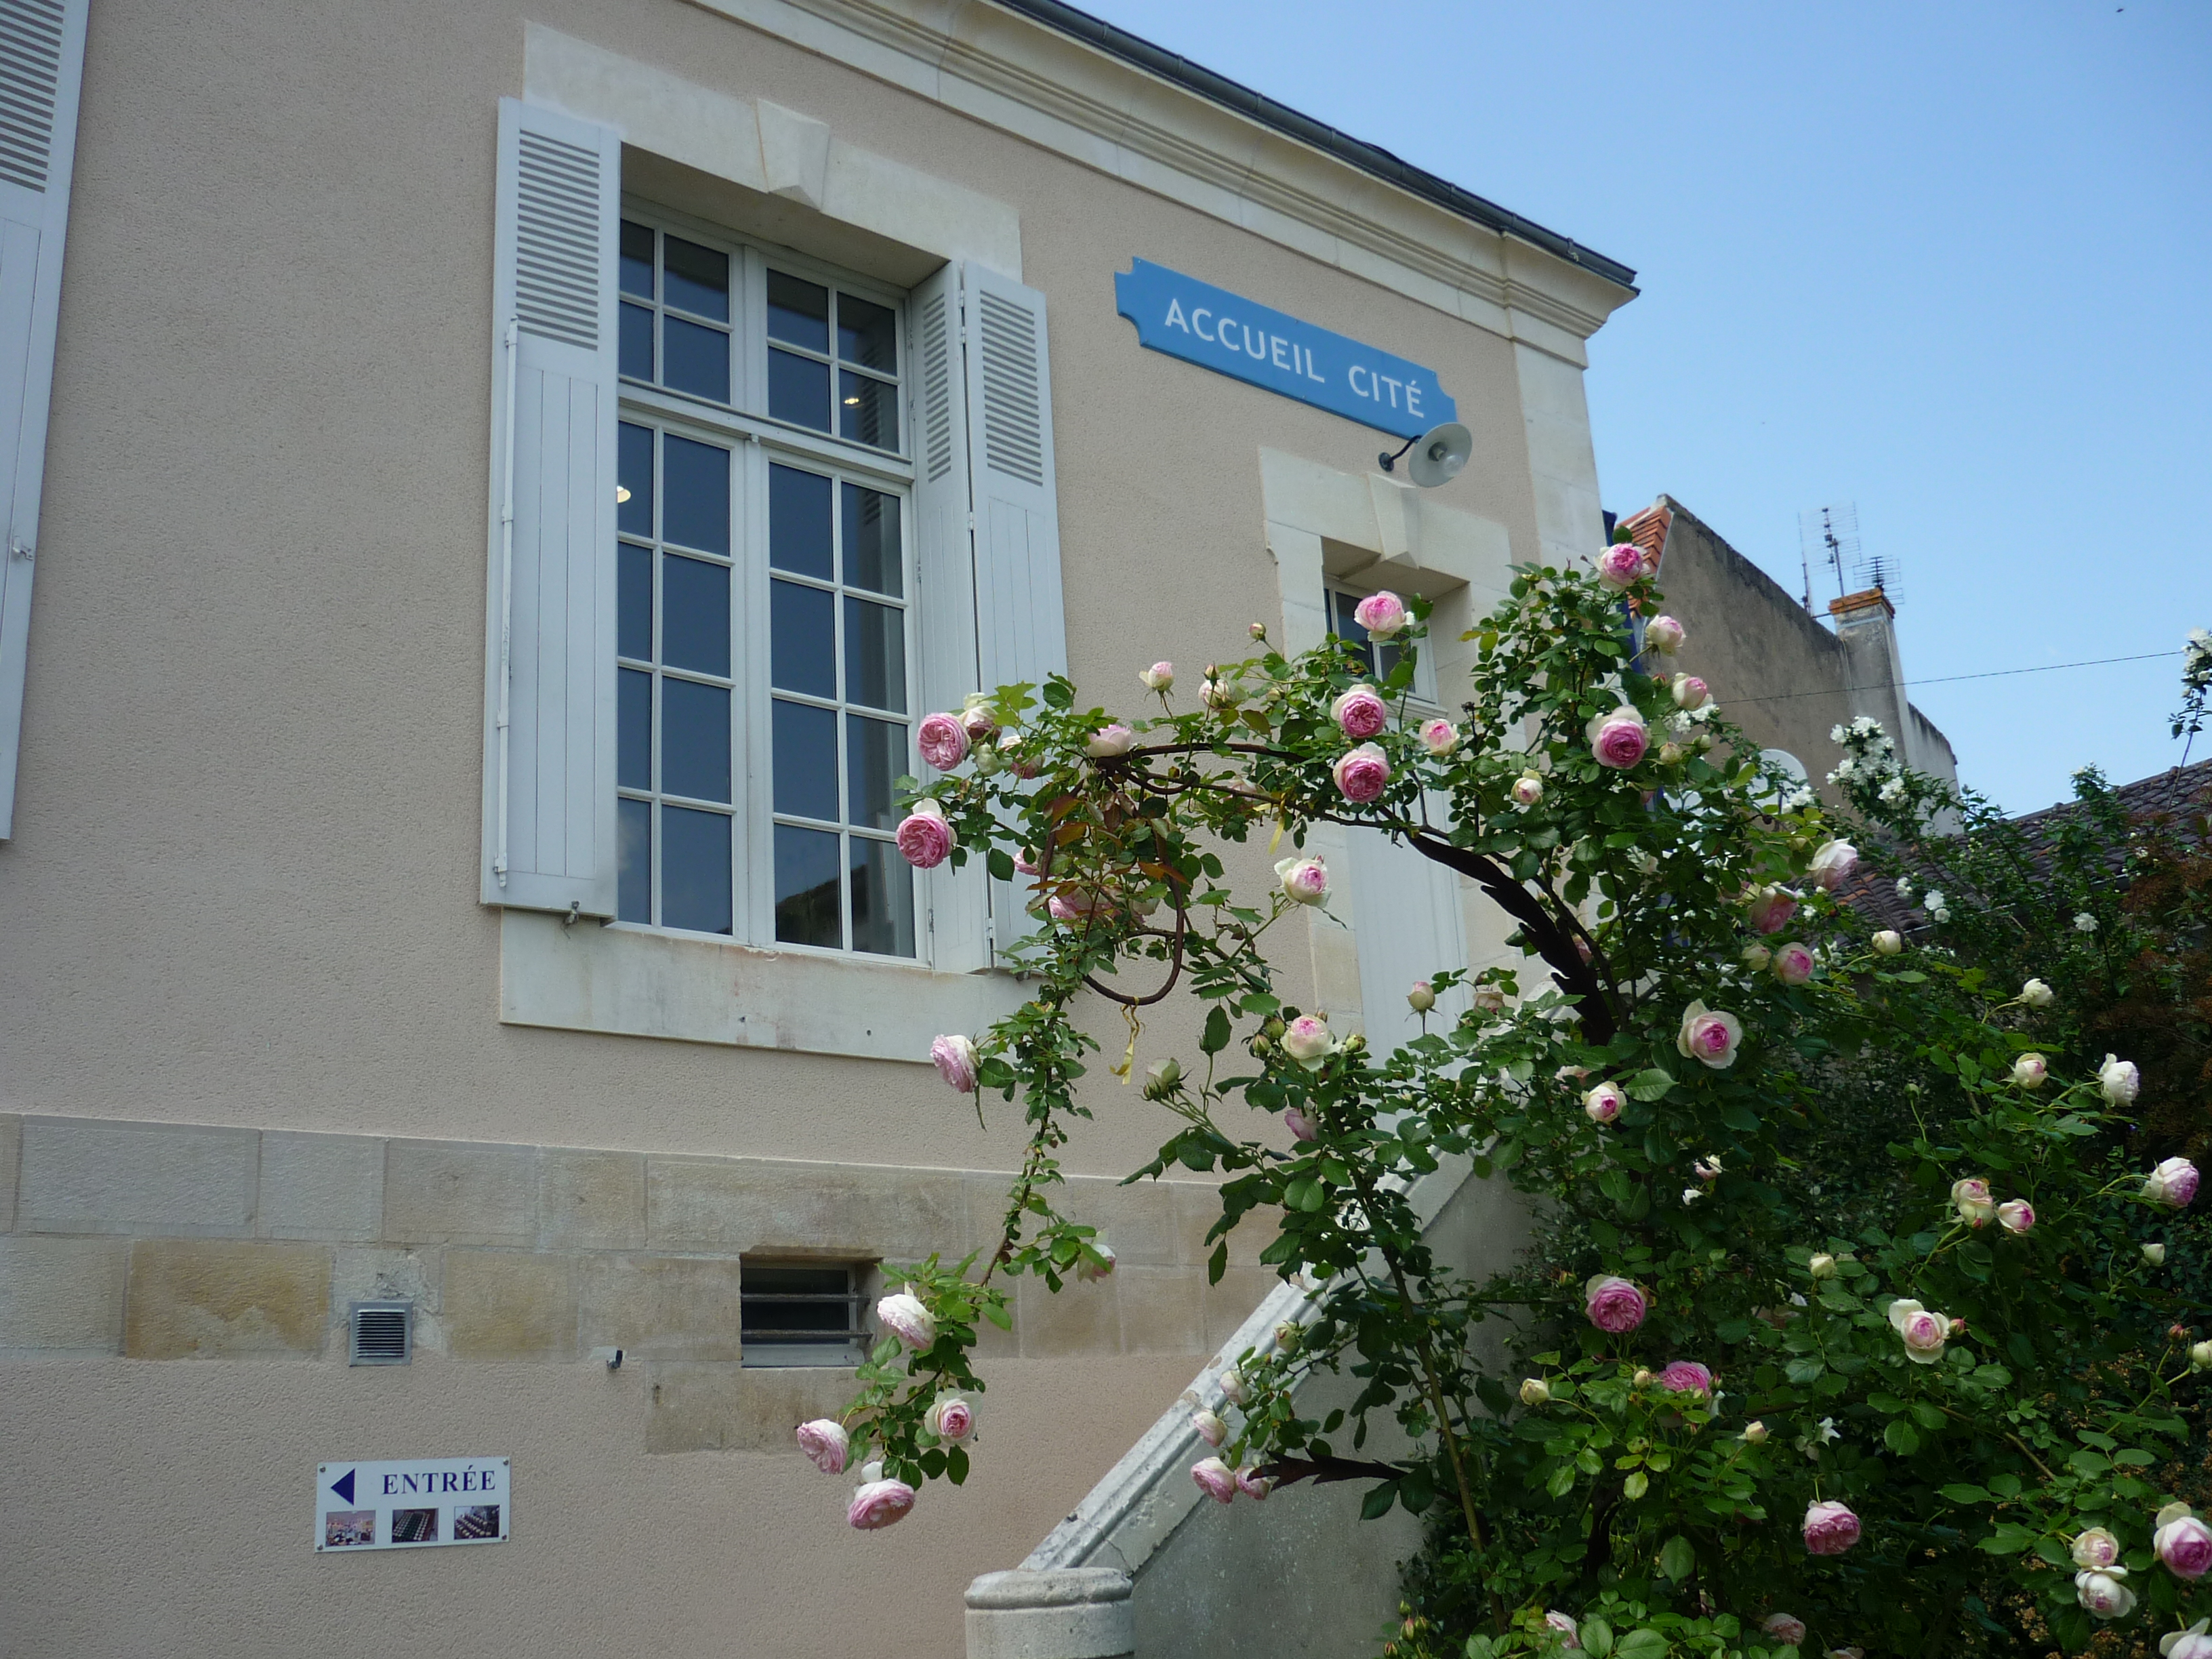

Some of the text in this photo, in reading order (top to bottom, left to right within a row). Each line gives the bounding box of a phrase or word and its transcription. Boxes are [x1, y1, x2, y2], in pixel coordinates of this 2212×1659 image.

[1165, 298, 1424, 418] ACCUEIL CITÉ
[382, 1465, 496, 1495] ENTRÉE
